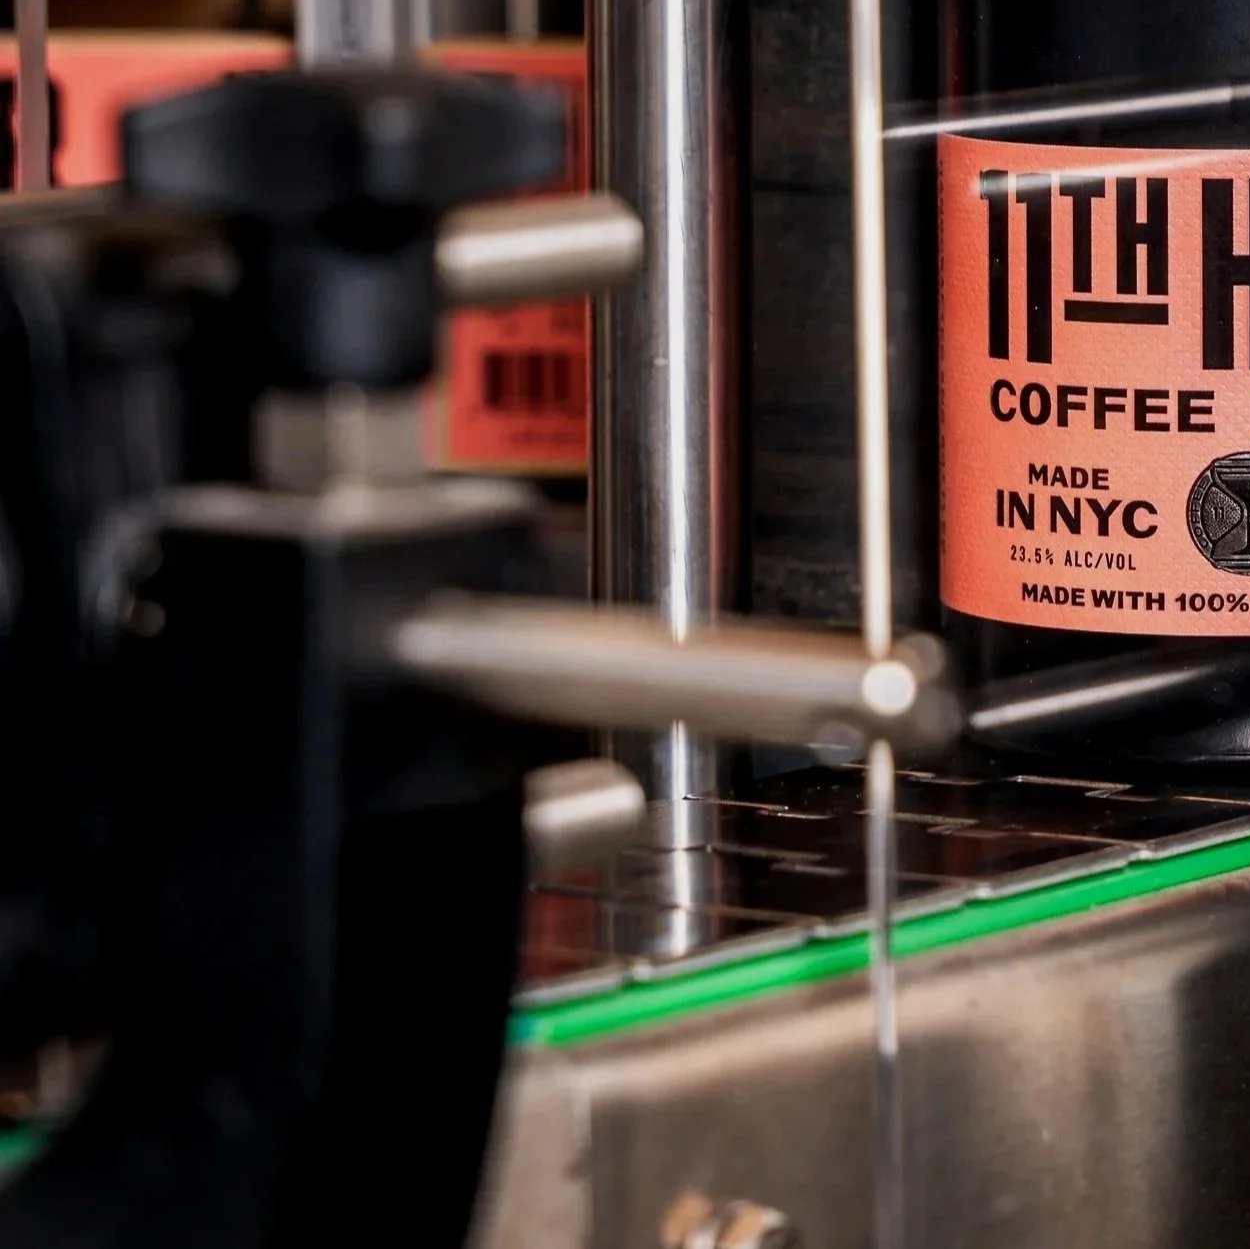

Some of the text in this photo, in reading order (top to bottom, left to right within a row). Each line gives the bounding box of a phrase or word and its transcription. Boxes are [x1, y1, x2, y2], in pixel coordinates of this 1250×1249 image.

[980, 169, 1169, 364] 11TH
[990, 378, 1216, 433] COFFEE
[1028, 462, 1110, 490] MADE
[996, 489, 1159, 539] IN NYC
[1191, 478, 1208, 547] COFFEE
[1010, 544, 1137, 570] 23.5% ALC/VOL
[1021, 582, 1086, 607] MADE
[1090, 588, 1166, 612] WITH
[1174, 593, 1250, 613] 100%
